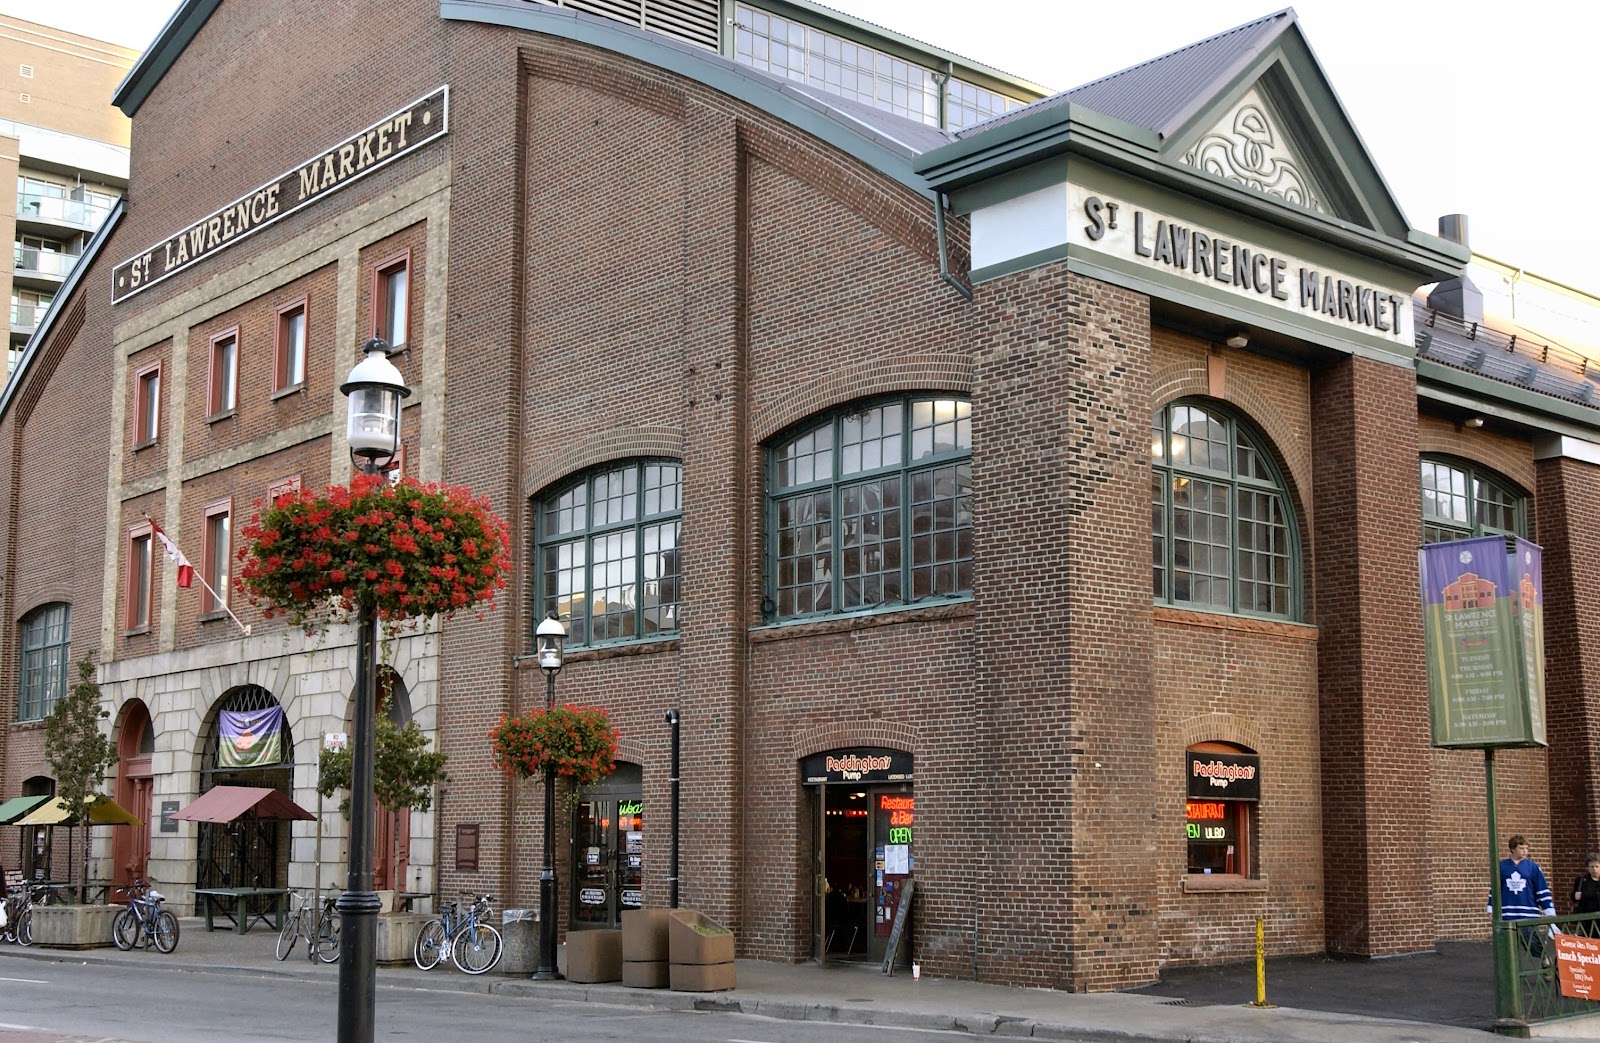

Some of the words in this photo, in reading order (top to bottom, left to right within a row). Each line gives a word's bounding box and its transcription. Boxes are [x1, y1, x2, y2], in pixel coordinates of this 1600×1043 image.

[164, 183, 280, 272] LAWRENCE
[298, 111, 412, 201] MARKET
[1134, 211, 1289, 300] LAWRENCE
[1299, 267, 1404, 335] MARKET
[1454, 610, 1497, 621] LAWRENCE
[1455, 619, 1489, 629] MARKET
[826, 754, 891, 774] Paddington's
[1193, 760, 1256, 782] Paddington's
[843, 770, 862, 781] Pump
[1210, 776, 1228, 788] Pump
[890, 811, 898, 825] &
[890, 827, 912, 844] OPEN
[1186, 823, 1200, 839] EN
[1557, 949, 1577, 961] Lunch
